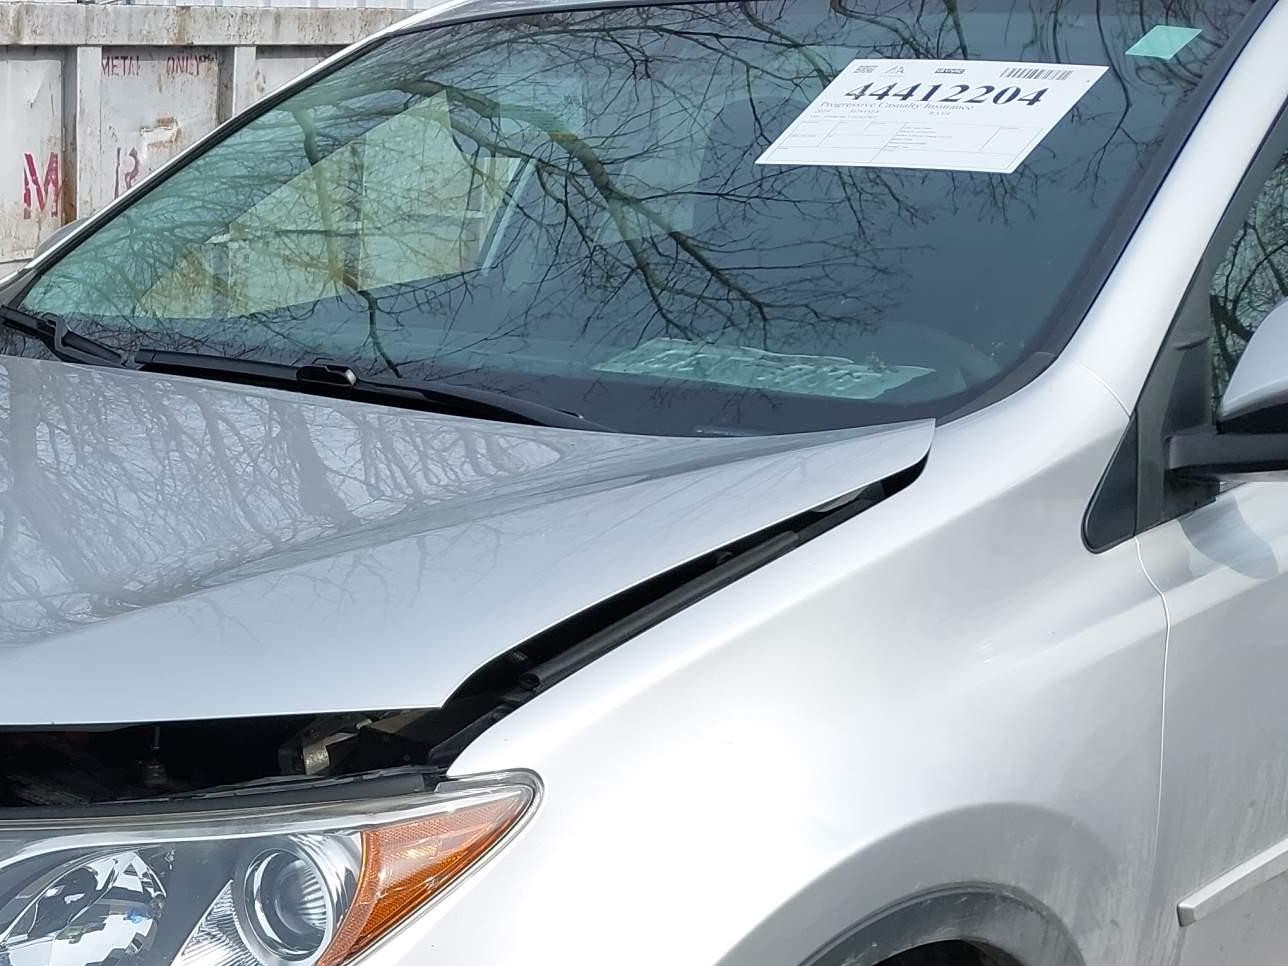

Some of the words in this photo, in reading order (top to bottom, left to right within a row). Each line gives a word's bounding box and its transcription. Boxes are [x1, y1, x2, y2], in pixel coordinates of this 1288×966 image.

[166, 56, 200, 77] ONLY
[844, 82, 1049, 106] 44412204
[820, 101, 876, 109] Progressive
[878, 102, 920, 110] Casualty
[923, 103, 974, 111] Insurance
[23, 153, 59, 219] M
